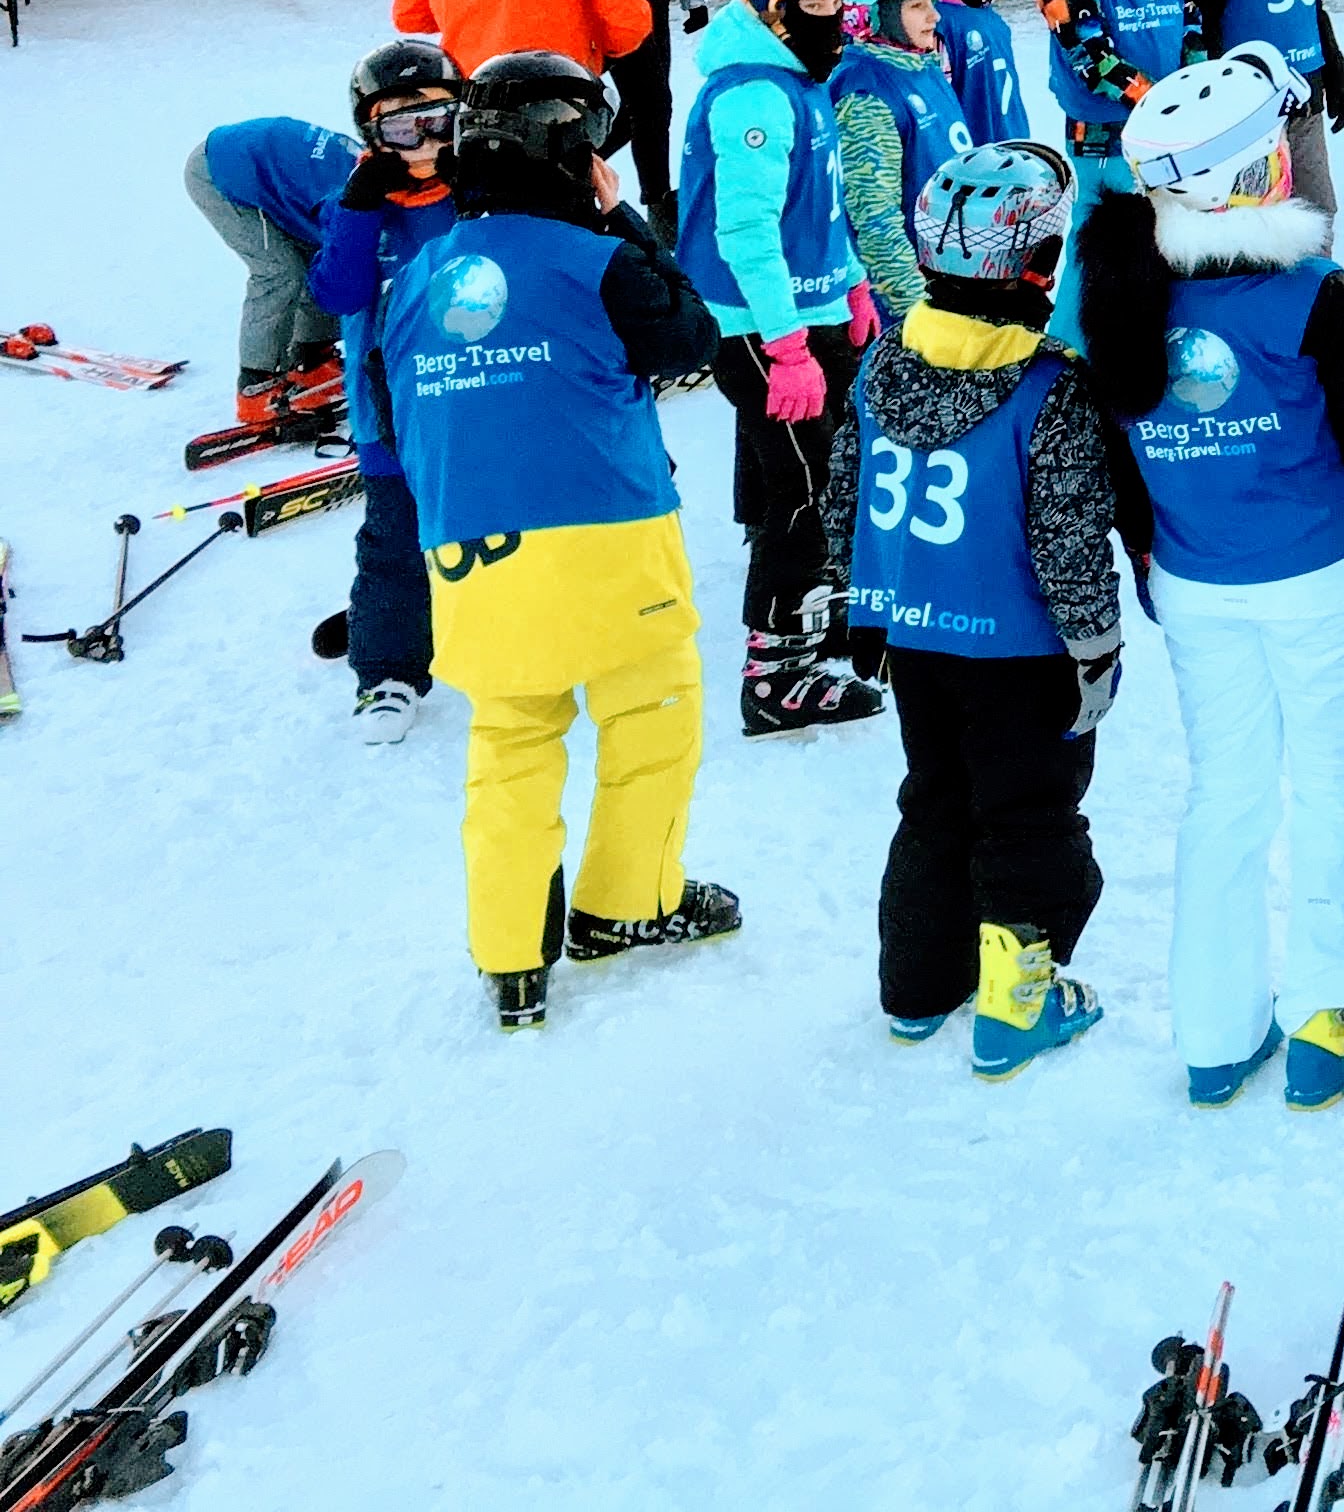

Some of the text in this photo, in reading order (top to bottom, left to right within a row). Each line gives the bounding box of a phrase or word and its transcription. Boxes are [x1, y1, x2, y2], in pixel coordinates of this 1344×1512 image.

[1115, 2, 1182, 20] Beg-Travel
[413, 341, 552, 376] Berg-Travel
[416, 371, 524, 397] Berg-Travel.com
[1136, 412, 1282, 445] Berg-Travel
[1145, 442, 1257, 463] Berg-Travel.com
[276, 488, 330, 521] SC
[869, 435, 970, 545] 33
